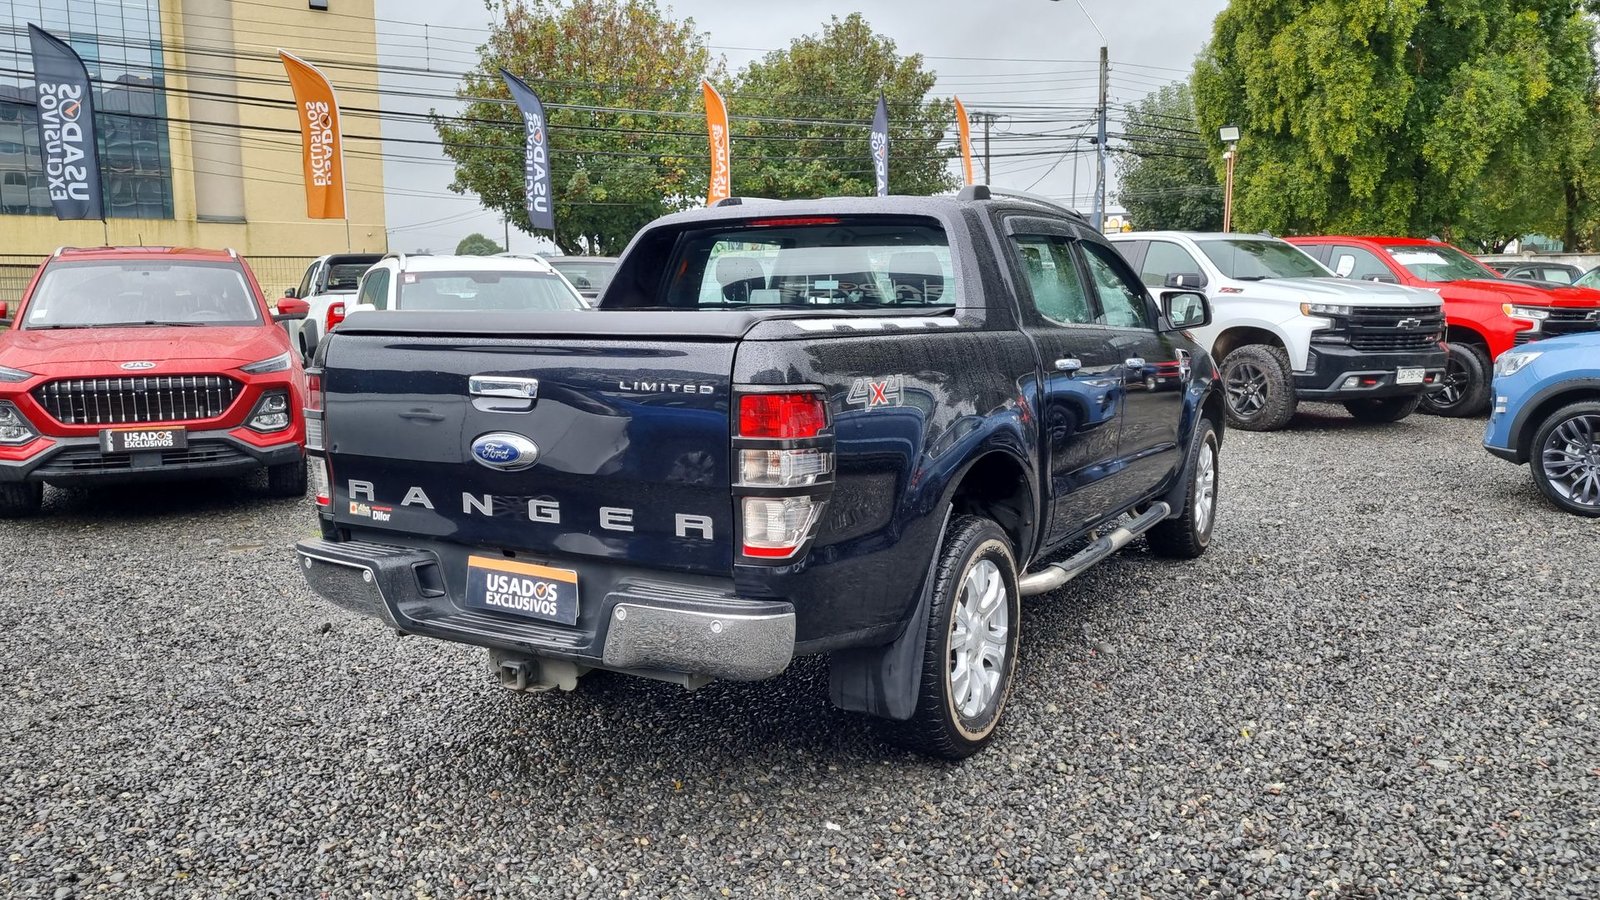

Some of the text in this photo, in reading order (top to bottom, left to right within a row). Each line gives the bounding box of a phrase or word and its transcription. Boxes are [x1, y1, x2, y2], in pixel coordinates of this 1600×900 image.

[619, 380, 714, 395] LIMITED
[124, 431, 173, 441] USADOS
[124, 439, 173, 448] EXCLUSIVOS
[482, 442, 510, 460] Ford
[348, 479, 714, 541] RANGER
[372, 510, 391, 521] Difor
[486, 573, 558, 601] USADOS
[485, 591, 557, 616] EXCLUSIVOS
